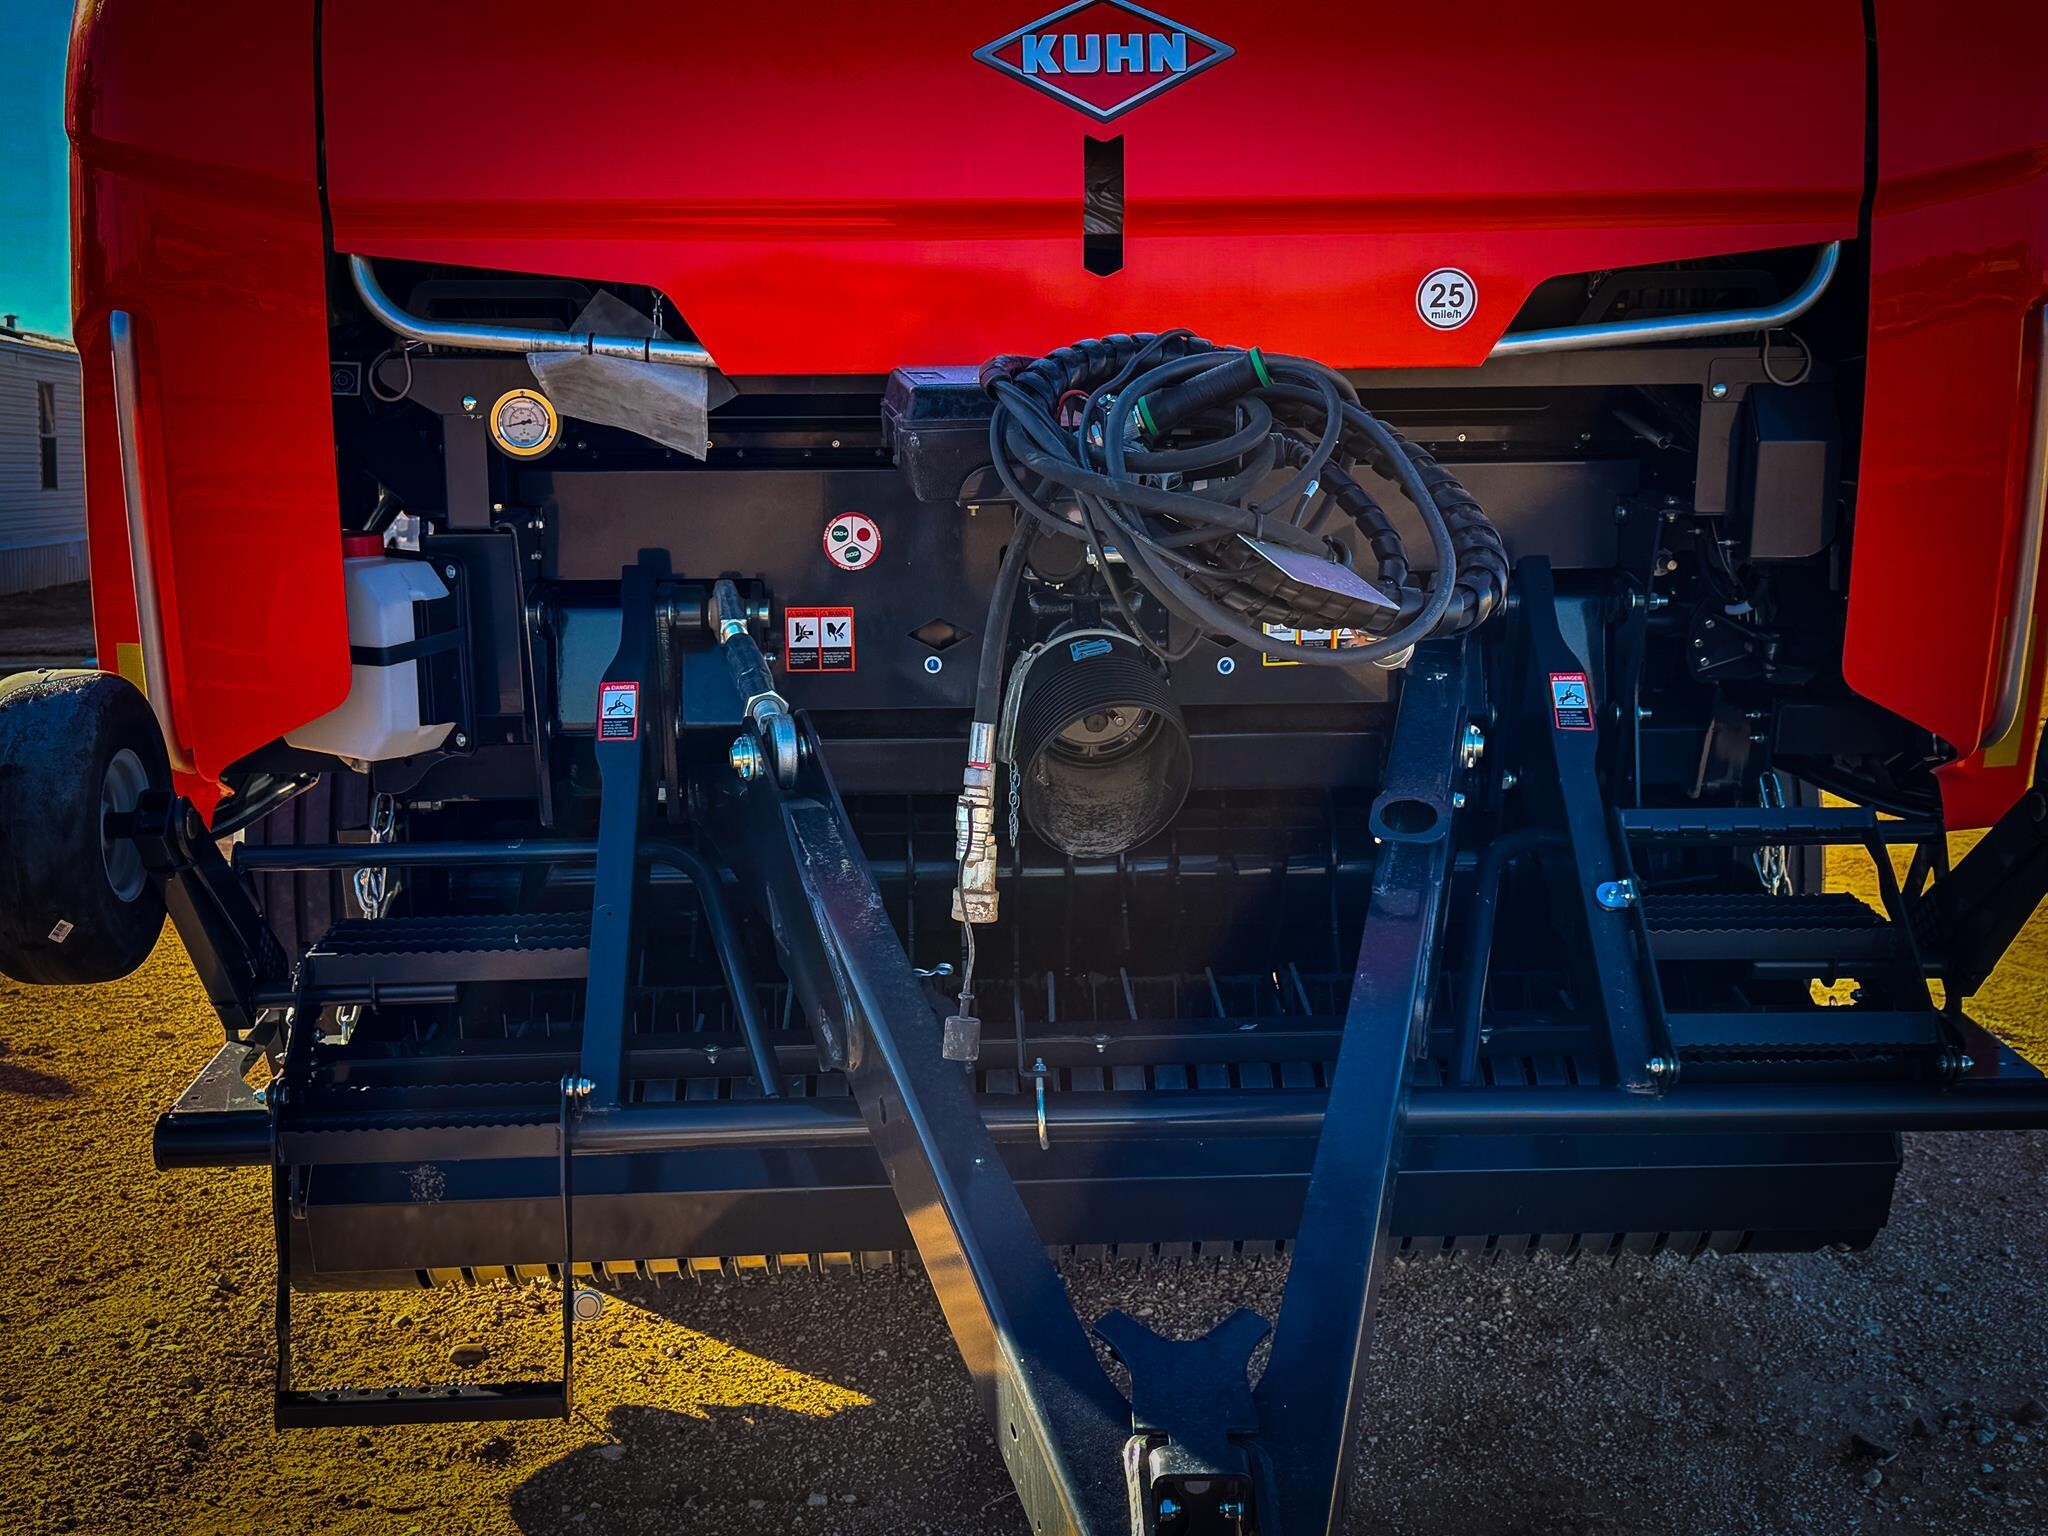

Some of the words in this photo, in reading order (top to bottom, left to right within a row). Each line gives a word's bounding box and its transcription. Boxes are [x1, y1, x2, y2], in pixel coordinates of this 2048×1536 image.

[1021, 33, 1188, 74] KUHN
[1430, 283, 1465, 308] 25
[1431, 309, 1462, 319] mile/h
